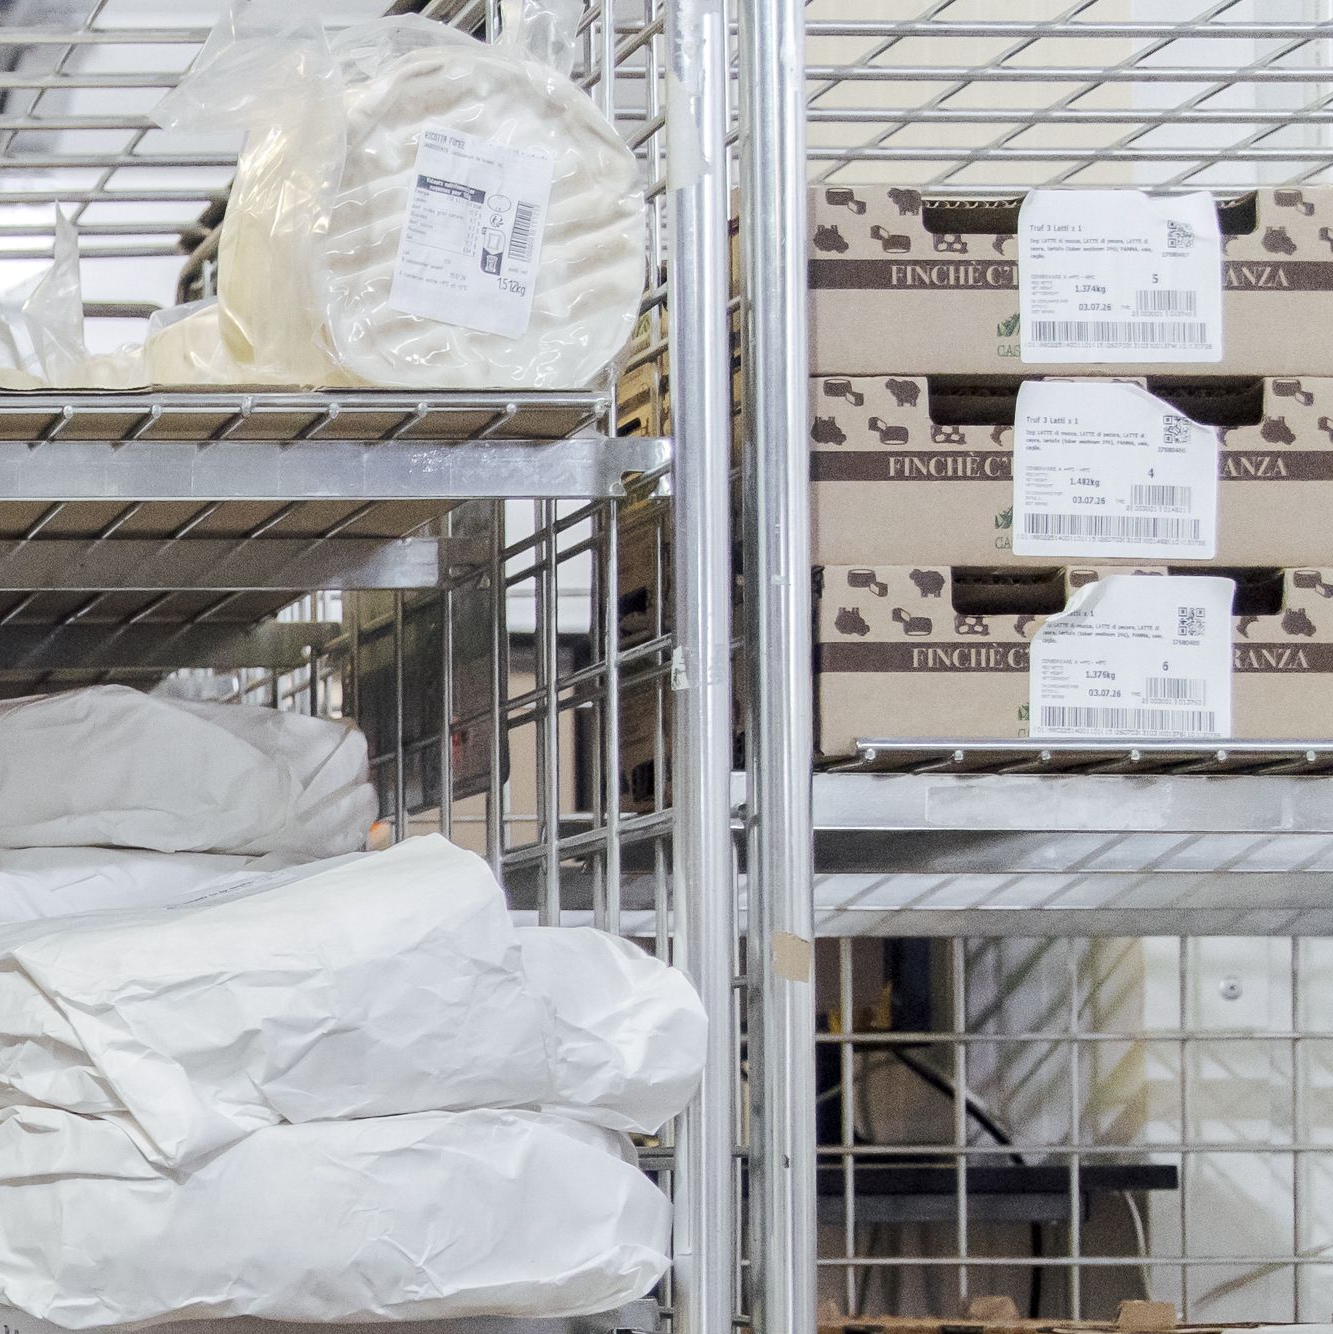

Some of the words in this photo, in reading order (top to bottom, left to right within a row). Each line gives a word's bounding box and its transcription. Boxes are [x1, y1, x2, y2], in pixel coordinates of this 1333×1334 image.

[1029, 224, 1044, 232] Truf
[1046, 224, 1051, 232] 3
[1053, 224, 1069, 232] Latti
[890, 259, 983, 286] FINCHÈ
[1225, 266, 1289, 288] ANZA
[1151, 273, 1159, 284] 5
[1075, 284, 1106, 294] 1.374kg
[1078, 303, 1112, 312] 03.07.26
[1025, 416, 1041, 424] Truf
[1050, 416, 1065, 424] Latti
[888, 451, 979, 478] FINCHÈ
[1223, 455, 1287, 478] ANZA
[1147, 468, 1155, 479] 4
[1072, 496, 1106, 505] 03.07.26
[912, 642, 1003, 669] FINCHÈ
[1232, 647, 1310, 670] RANZA
[1162, 661, 1169, 672] 6
[1085, 670, 1116, 680] 1.376kg
[1088, 689, 1122, 698] 03.07.26
